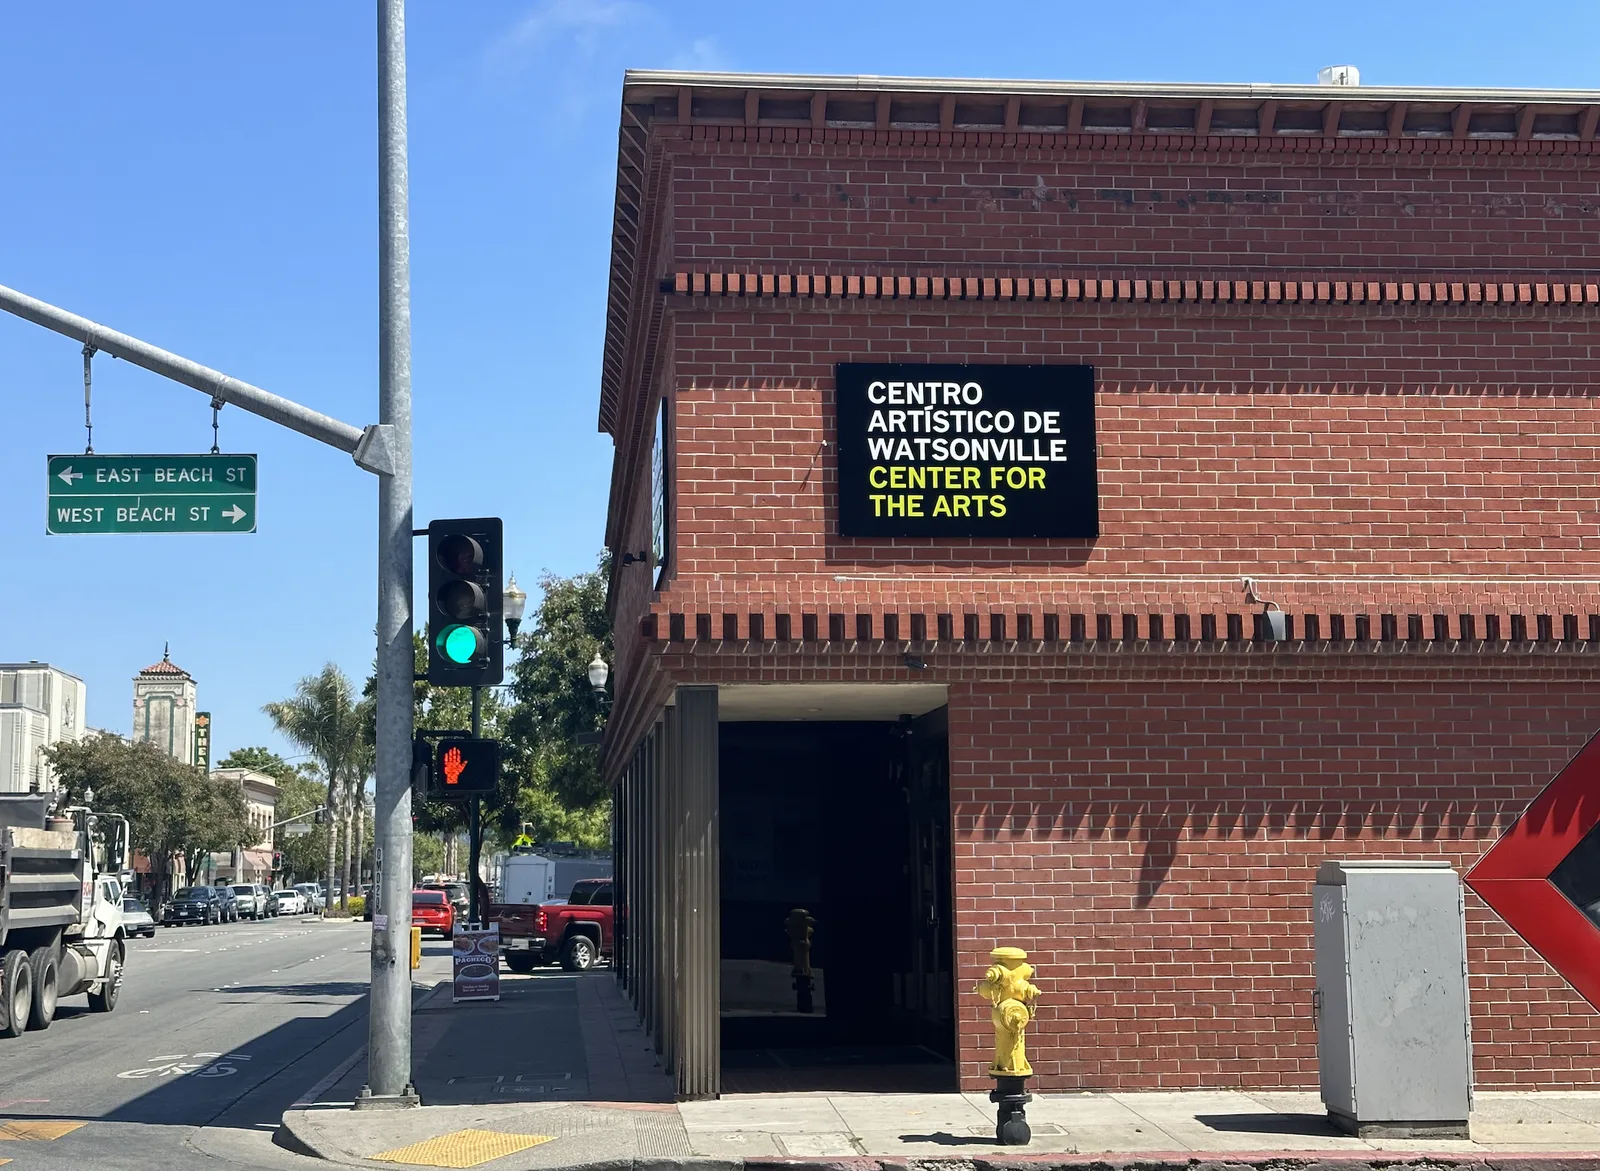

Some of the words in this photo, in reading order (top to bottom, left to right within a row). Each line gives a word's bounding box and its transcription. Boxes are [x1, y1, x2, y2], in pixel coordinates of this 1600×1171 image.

[867, 381, 983, 405] CENTRO
[867, 404, 1015, 434] ARTÍSTICO
[1023, 411, 1061, 434] DE
[867, 437, 1068, 461] WATSONVILLE
[96, 468, 141, 483] EAST
[154, 467, 213, 483] BEACH
[226, 467, 247, 482] ST
[869, 466, 981, 489] CENTER
[990, 466, 1046, 490] FOR
[57, 507, 105, 523] WEST
[116, 507, 176, 522] BEACH
[189, 506, 211, 521] ST
[868, 494, 925, 517] THE
[932, 494, 1007, 518] ARTS
